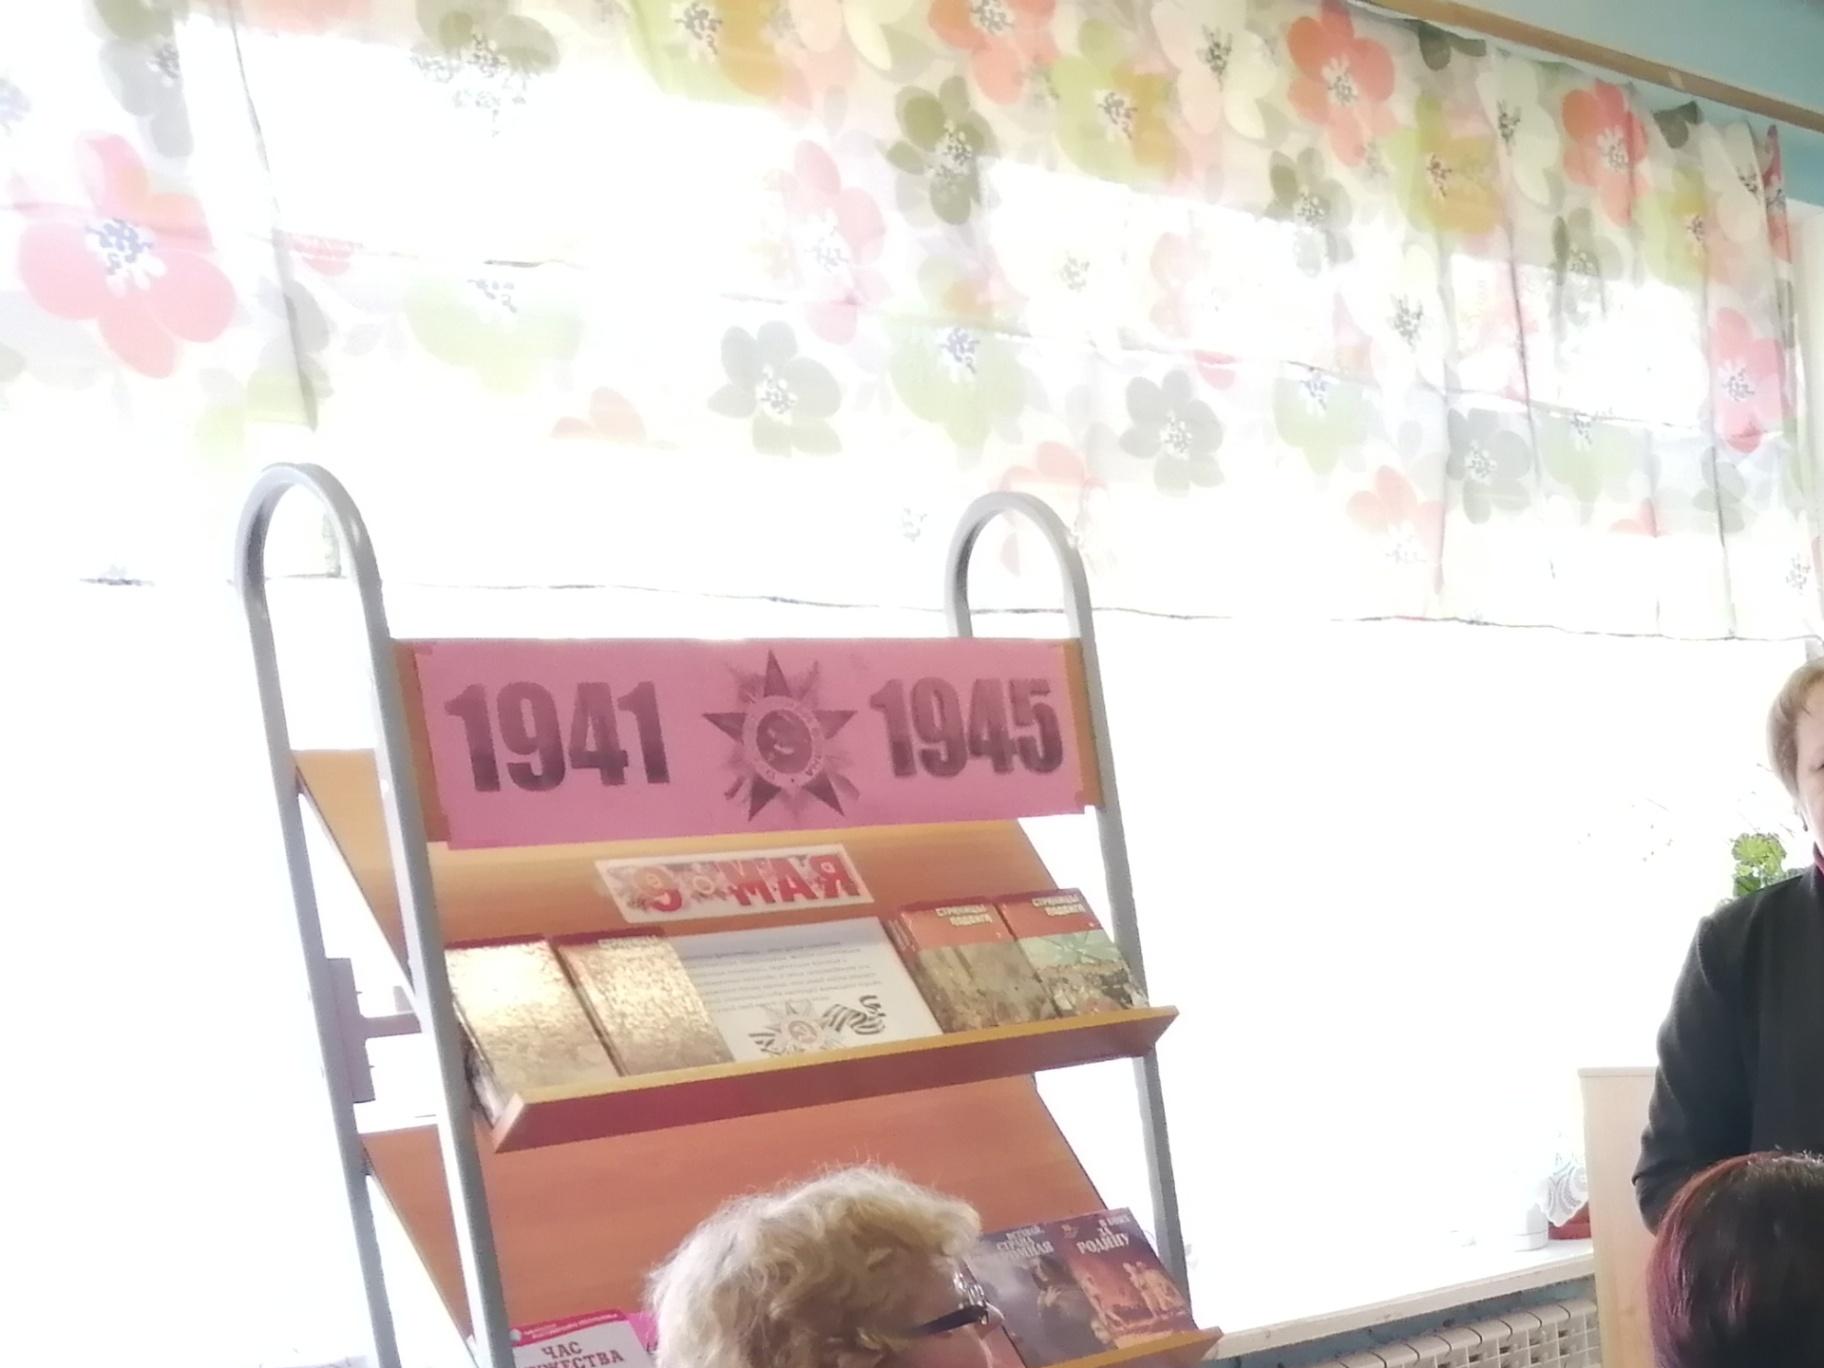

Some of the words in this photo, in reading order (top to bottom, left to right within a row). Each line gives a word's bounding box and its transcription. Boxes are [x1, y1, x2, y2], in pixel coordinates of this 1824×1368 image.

[444, 680, 670, 792] 1941
[869, 676, 1064, 778] 1945
[634, 864, 682, 912] 9
[715, 853, 861, 906] МАЯ
[1076, 1232, 1130, 1255] РОДИНУ
[542, 1341, 583, 1360] ЧАС
